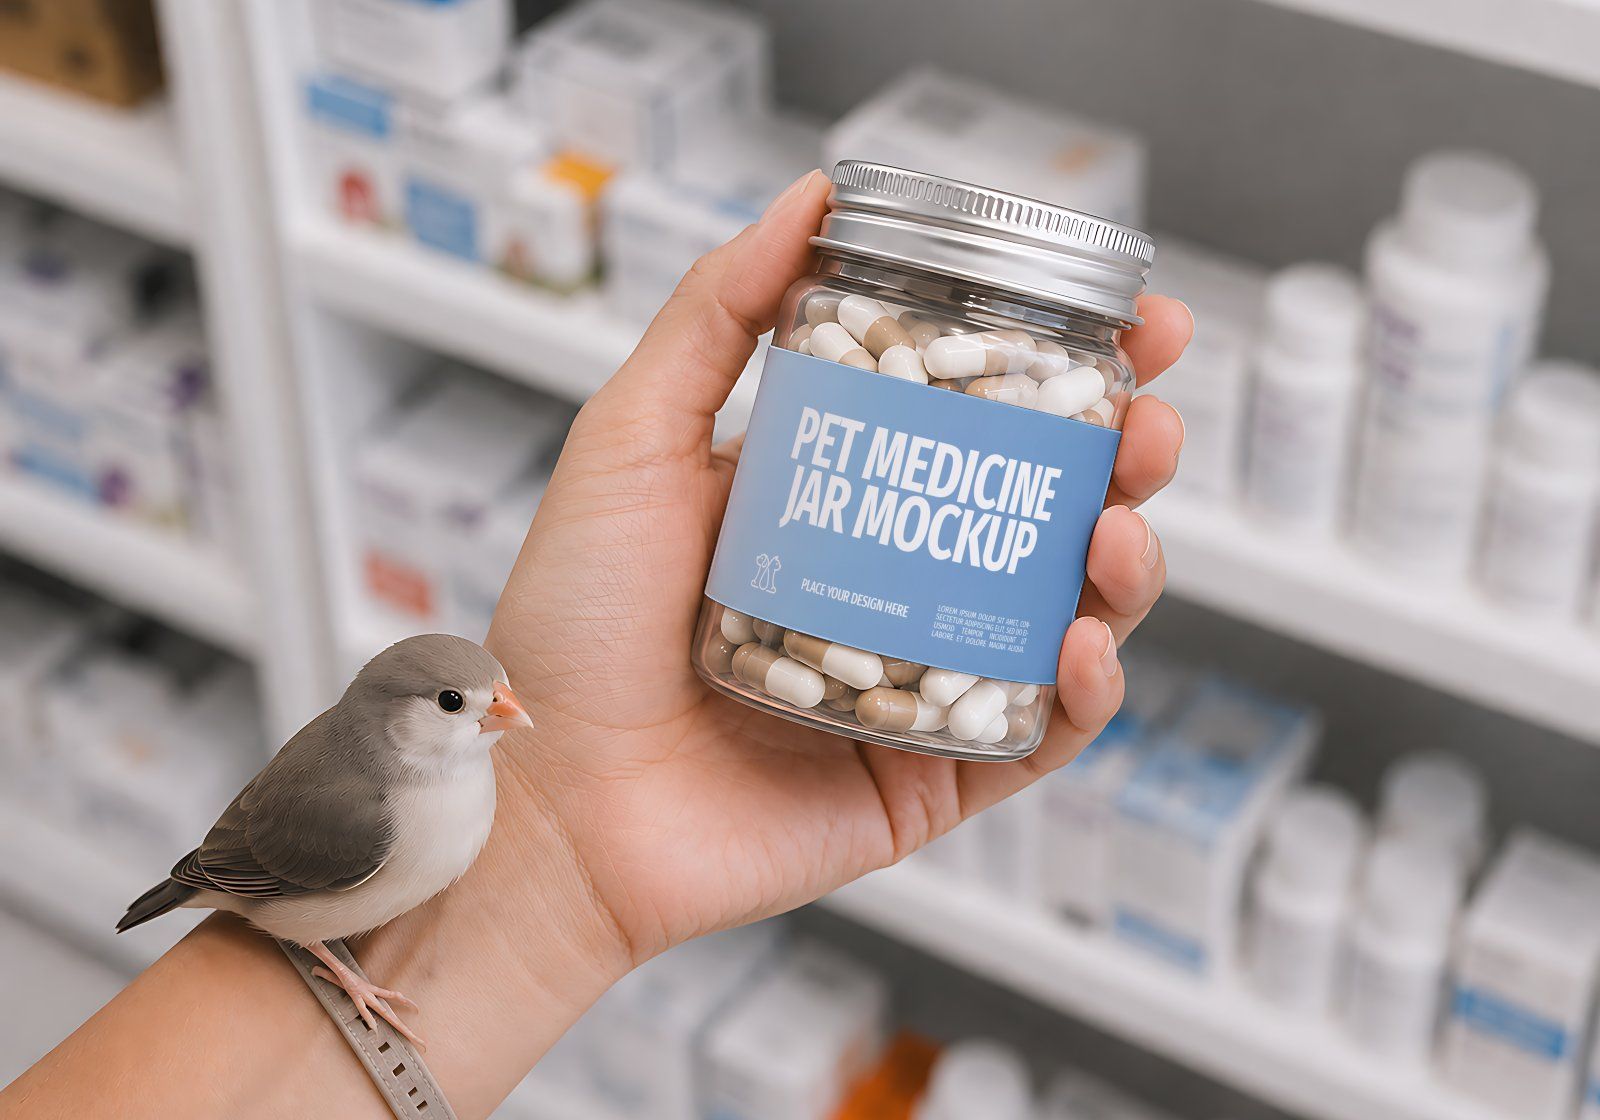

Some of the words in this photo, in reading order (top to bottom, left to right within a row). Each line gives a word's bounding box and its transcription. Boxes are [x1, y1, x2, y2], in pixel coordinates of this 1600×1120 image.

[790, 406, 866, 473] PET
[861, 426, 1062, 522] MEDICINE
[778, 464, 851, 534] JAR
[851, 484, 1038, 575] MOCKUP
[800, 578, 827, 596] PLACE
[827, 585, 850, 603] YOUR
[850, 592, 885, 612] DESIGN
[884, 600, 910, 618] HERE
[935, 612, 963, 625] SECTETUR
[964, 619, 994, 631] ADIPISCING
[937, 604, 958, 615] LOREM
[959, 609, 977, 619] IPSUM
[977, 612, 997, 622] DOLOR
[996, 616, 1006, 625] SIT
[931, 629, 954, 641] LABORE
[956, 635, 964, 643] ET
[965, 636, 987, 648] DOLORE
[988, 641, 1006, 651] MAGNA
[961, 627, 984, 638] TEMPOR
